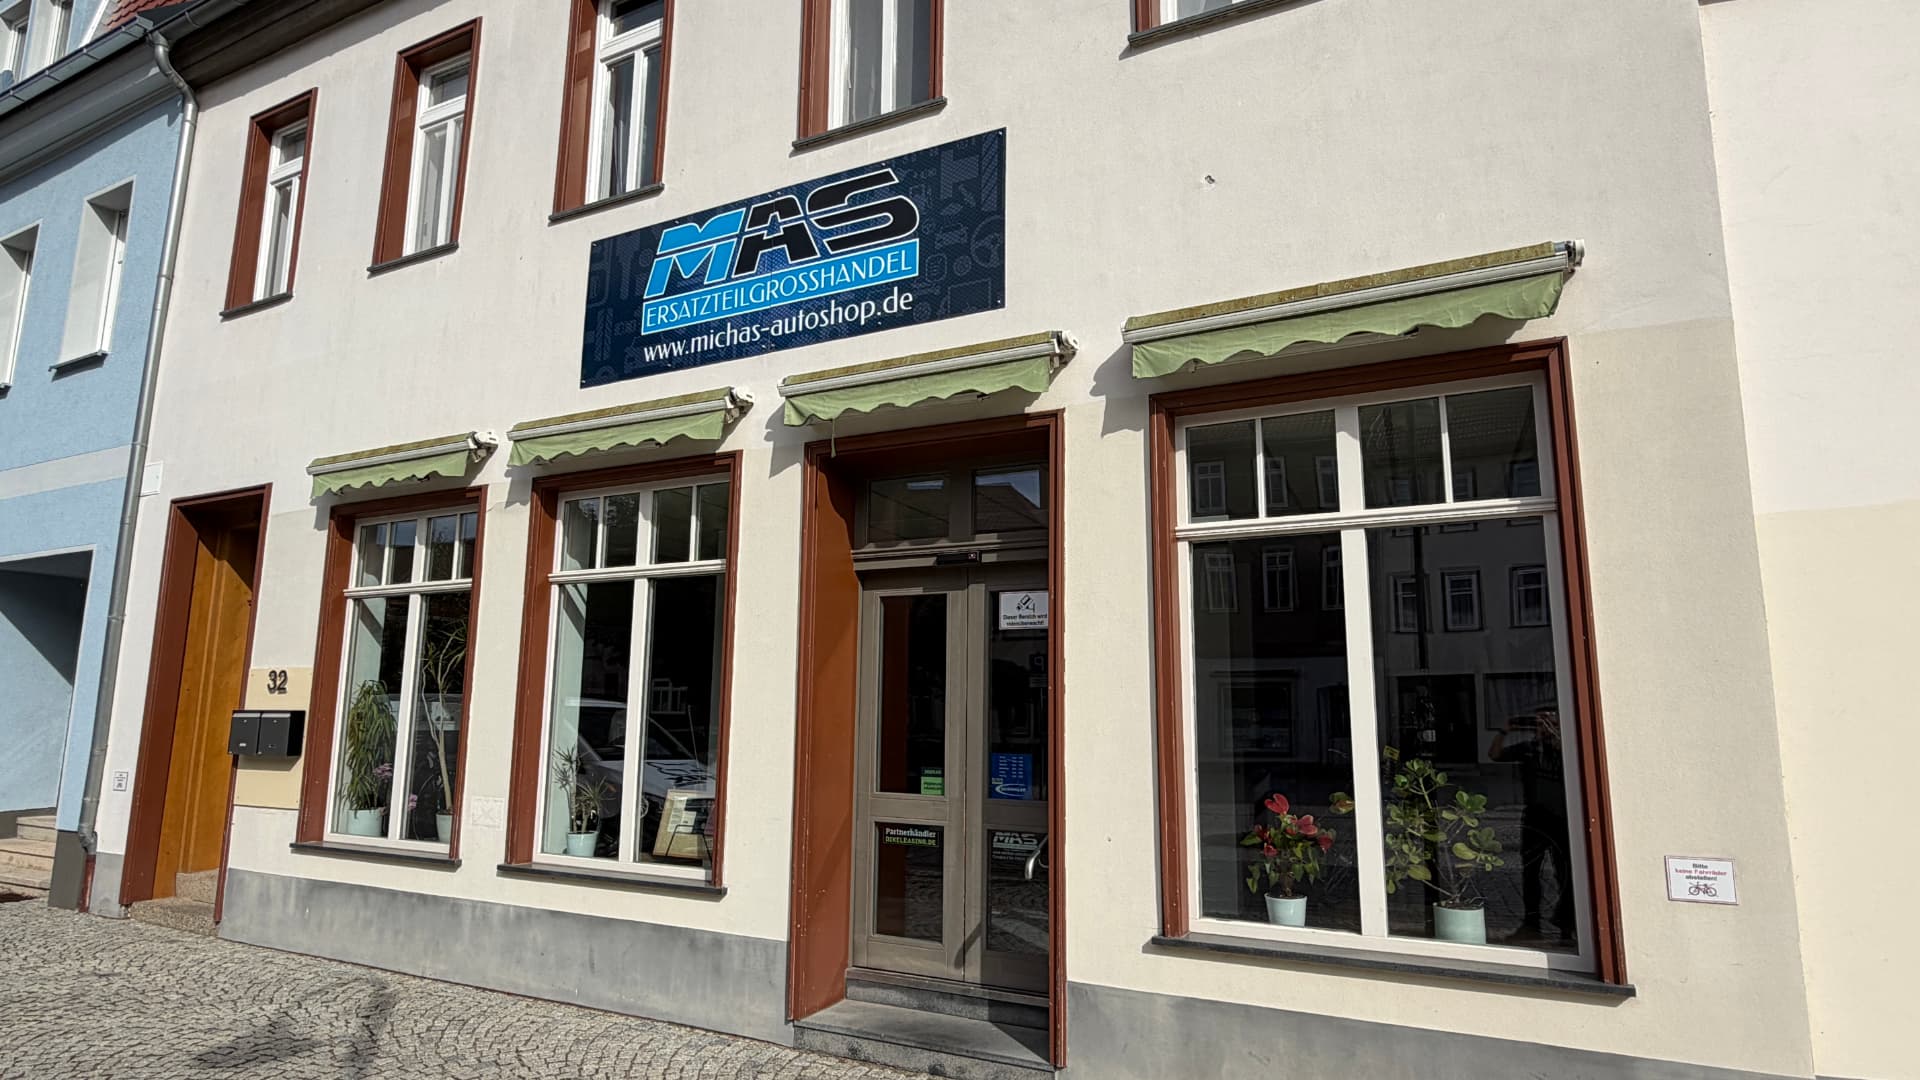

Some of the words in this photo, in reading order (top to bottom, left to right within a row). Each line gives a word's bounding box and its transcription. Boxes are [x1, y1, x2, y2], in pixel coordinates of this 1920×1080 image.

[643, 168, 919, 299] MAS
[646, 250, 912, 328] ERSATZTEILGROSSHANDEL
[644, 286, 914, 363] www.michas-autoshop.de
[267, 670, 288, 694] 32
[885, 827, 936, 838] Partnerhändler
[993, 832, 1038, 845] MAS
